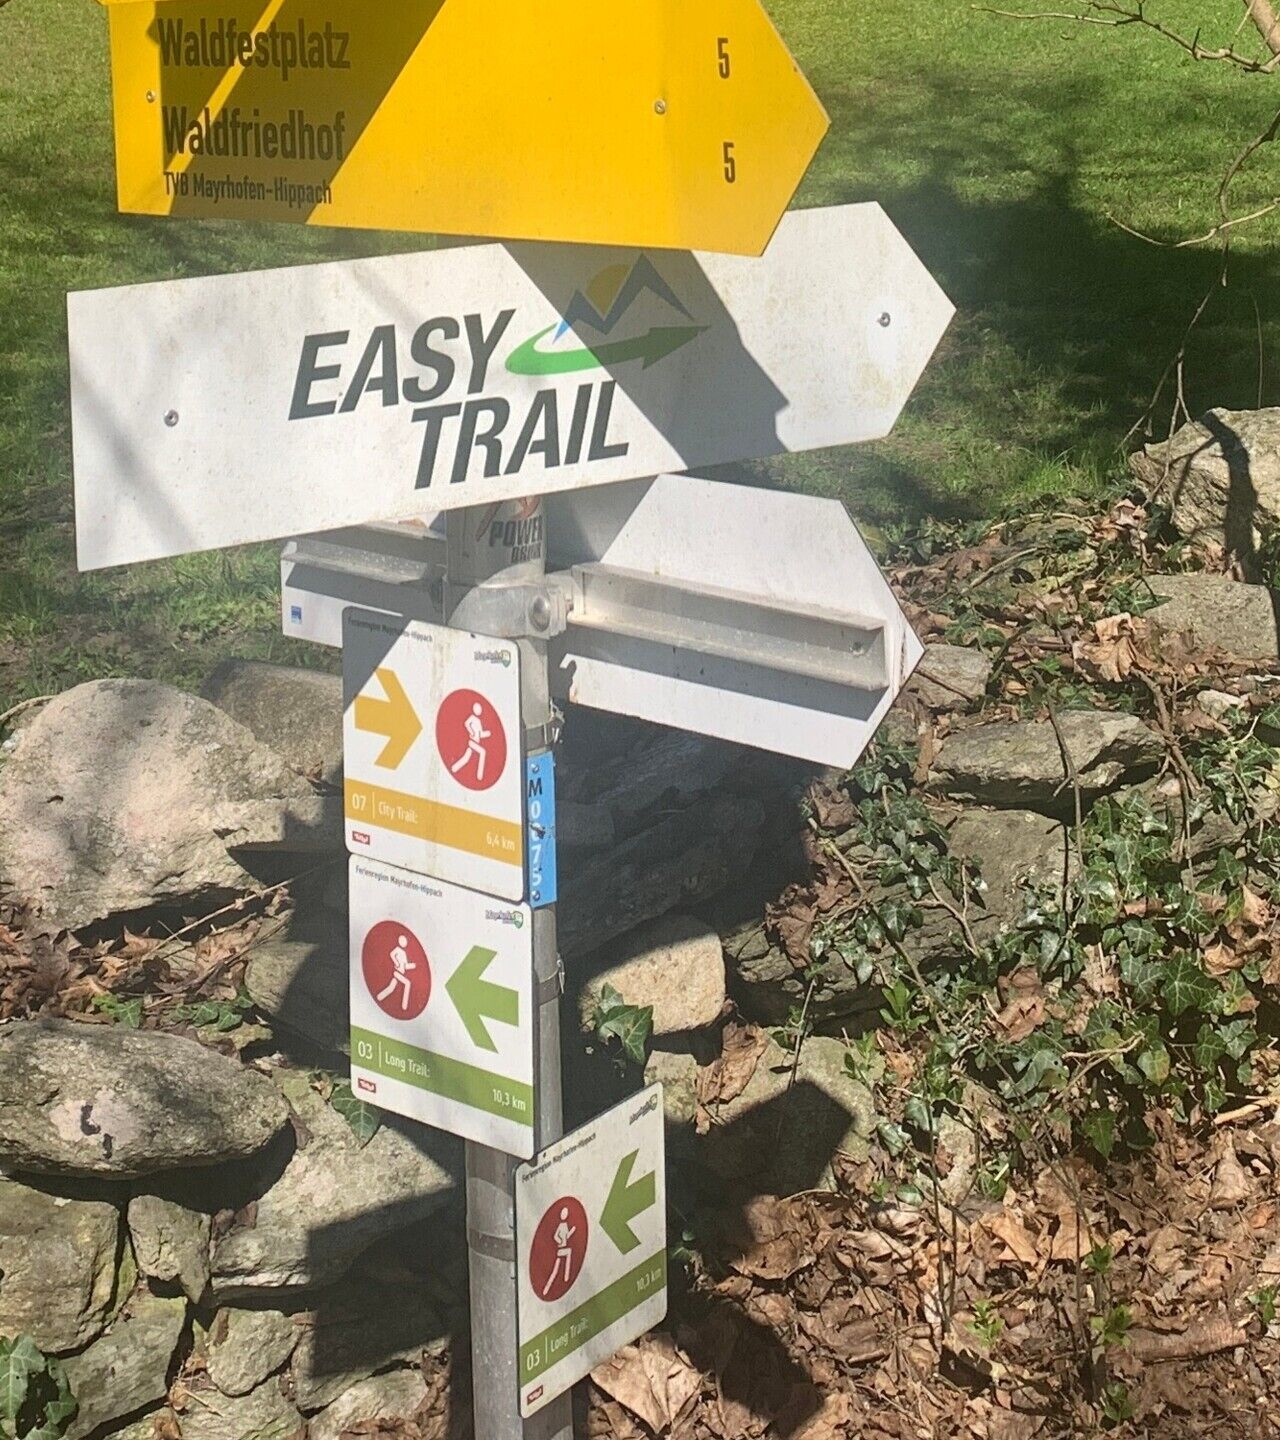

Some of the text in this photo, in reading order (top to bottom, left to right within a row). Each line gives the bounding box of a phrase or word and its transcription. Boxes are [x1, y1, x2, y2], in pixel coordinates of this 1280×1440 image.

[157, 17, 731, 81] Waldfestplatz 5
[161, 106, 736, 184] Waldfriedhof 5
[164, 171, 332, 208] TVB Mayrhofen-Hippach
[288, 308, 517, 420] EASY
[412, 379, 630, 489] TRAIL
[352, 793, 366, 810] 07
[378, 801, 395, 819] City
[486, 831, 499, 847] 6,4
[501, 838, 515, 851] km
[358, 1041, 373, 1060] 03
[385, 1051, 406, 1072] Long
[492, 1088, 510, 1106] 10,3
[512, 1095, 526, 1111] km
[526, 1349, 540, 1371] 03
[550, 1332, 569, 1352] Long
